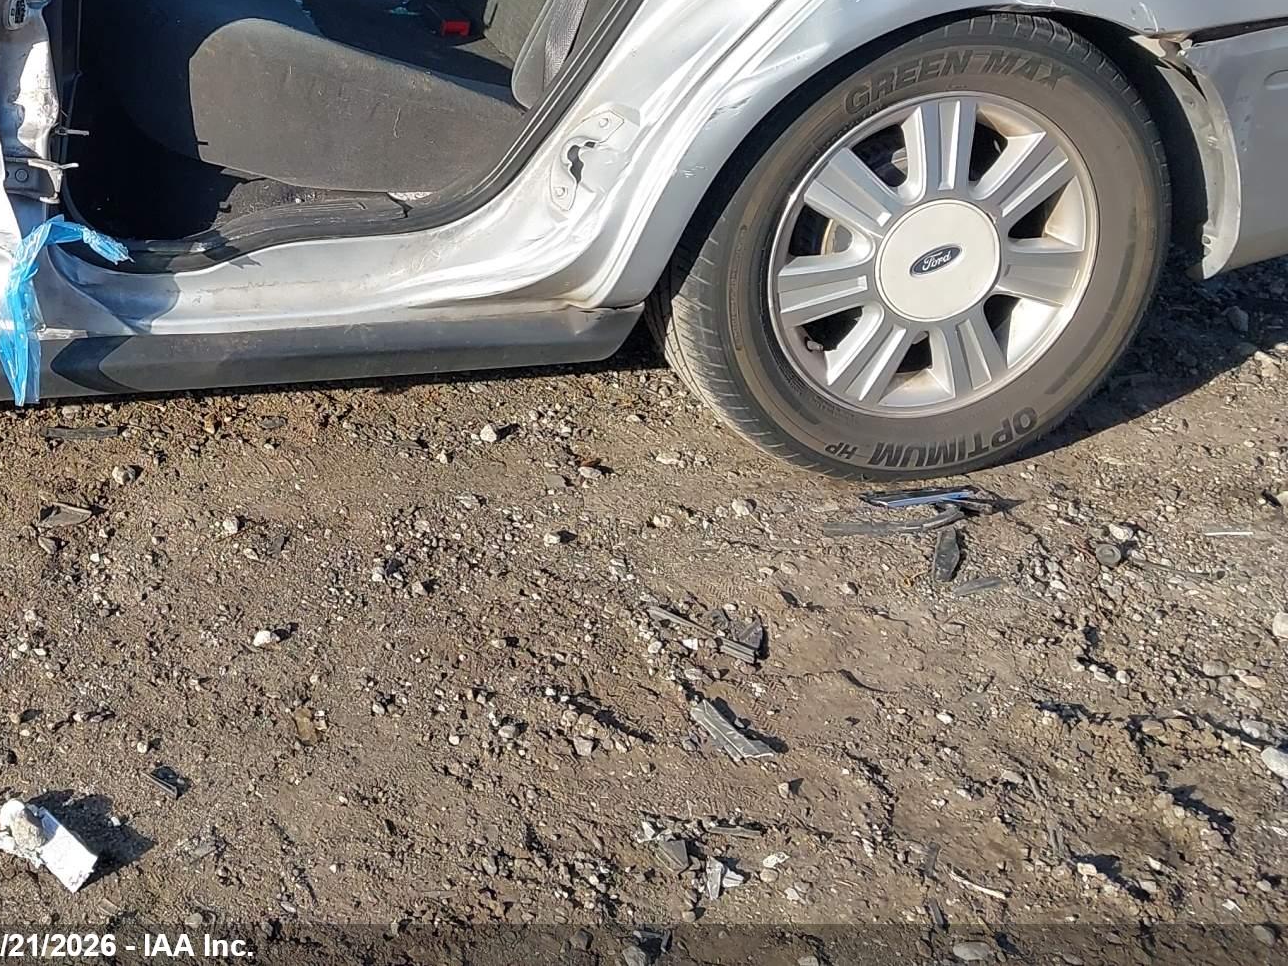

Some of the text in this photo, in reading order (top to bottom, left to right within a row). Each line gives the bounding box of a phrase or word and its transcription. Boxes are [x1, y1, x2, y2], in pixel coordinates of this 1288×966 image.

[922, 250, 952, 271] Ford
[868, 407, 1038, 467] OPTIMUM
[824, 442, 859, 460] HP
